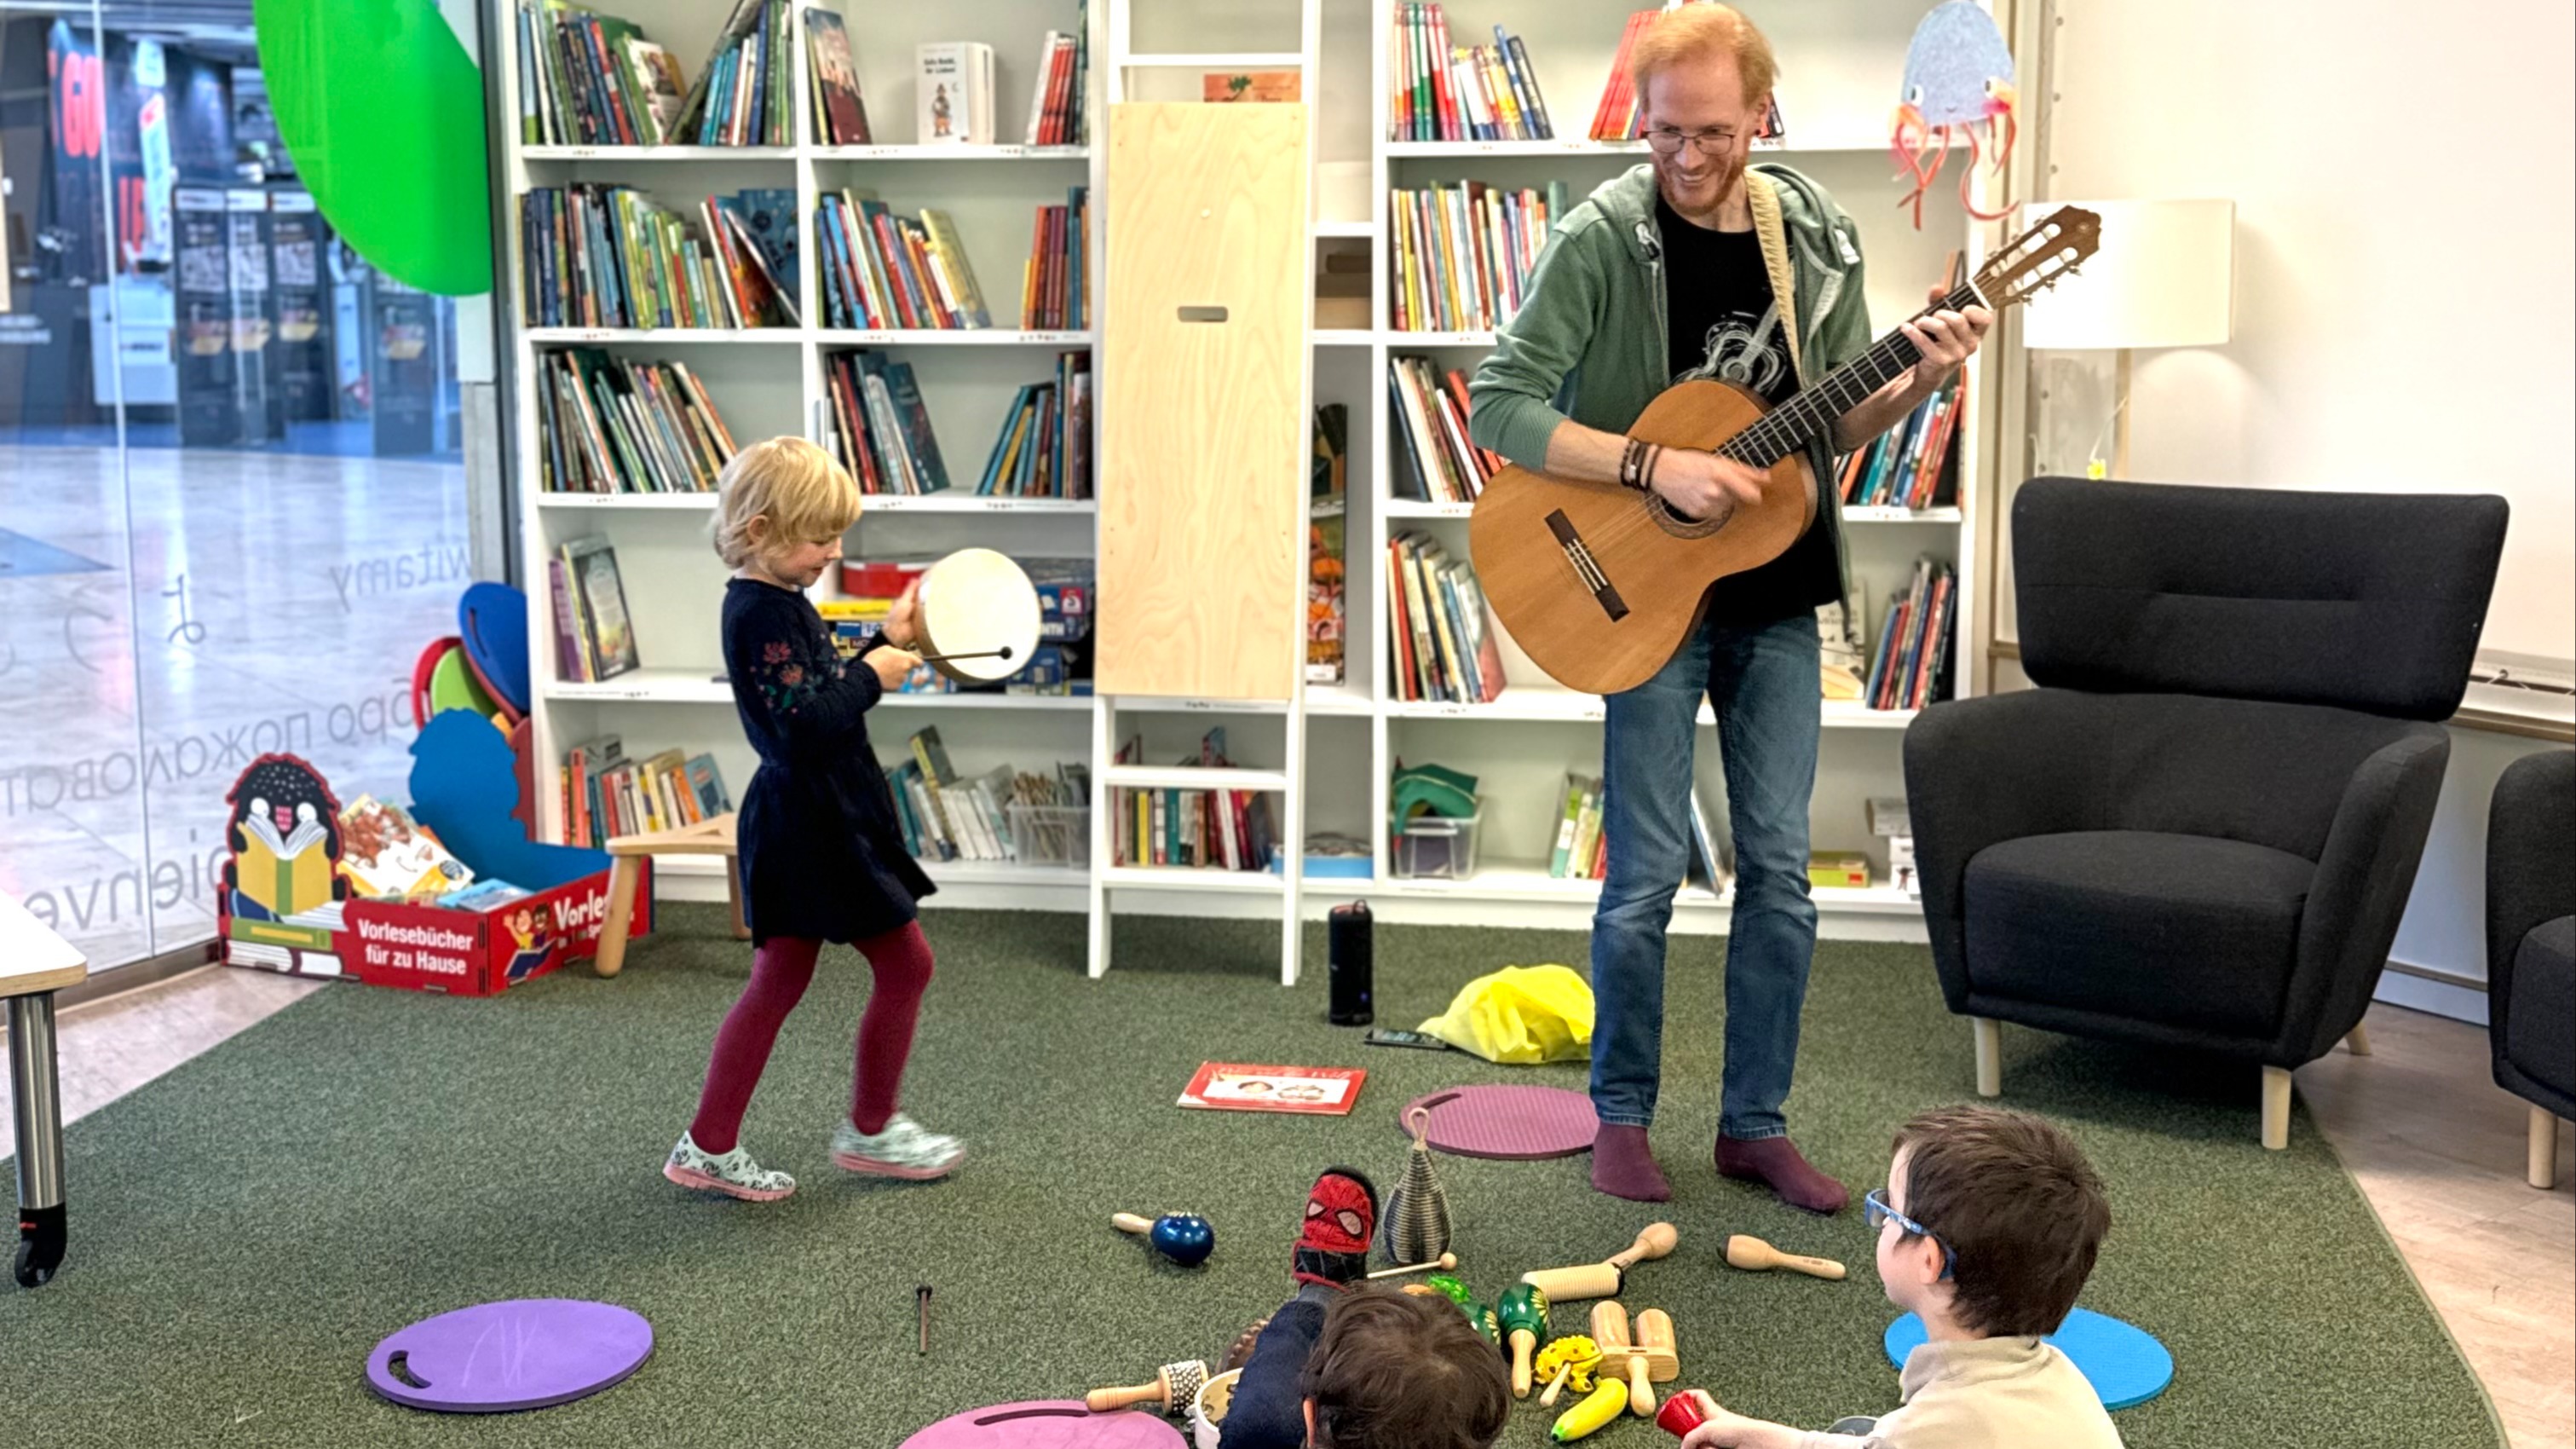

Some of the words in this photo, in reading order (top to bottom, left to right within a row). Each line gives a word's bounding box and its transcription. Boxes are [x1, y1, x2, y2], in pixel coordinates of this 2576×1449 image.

[358, 919, 474, 951] Vorlesebücher
[366, 945, 390, 964] für
[393, 952, 412, 968] zu
[417, 951, 466, 975] Hause
